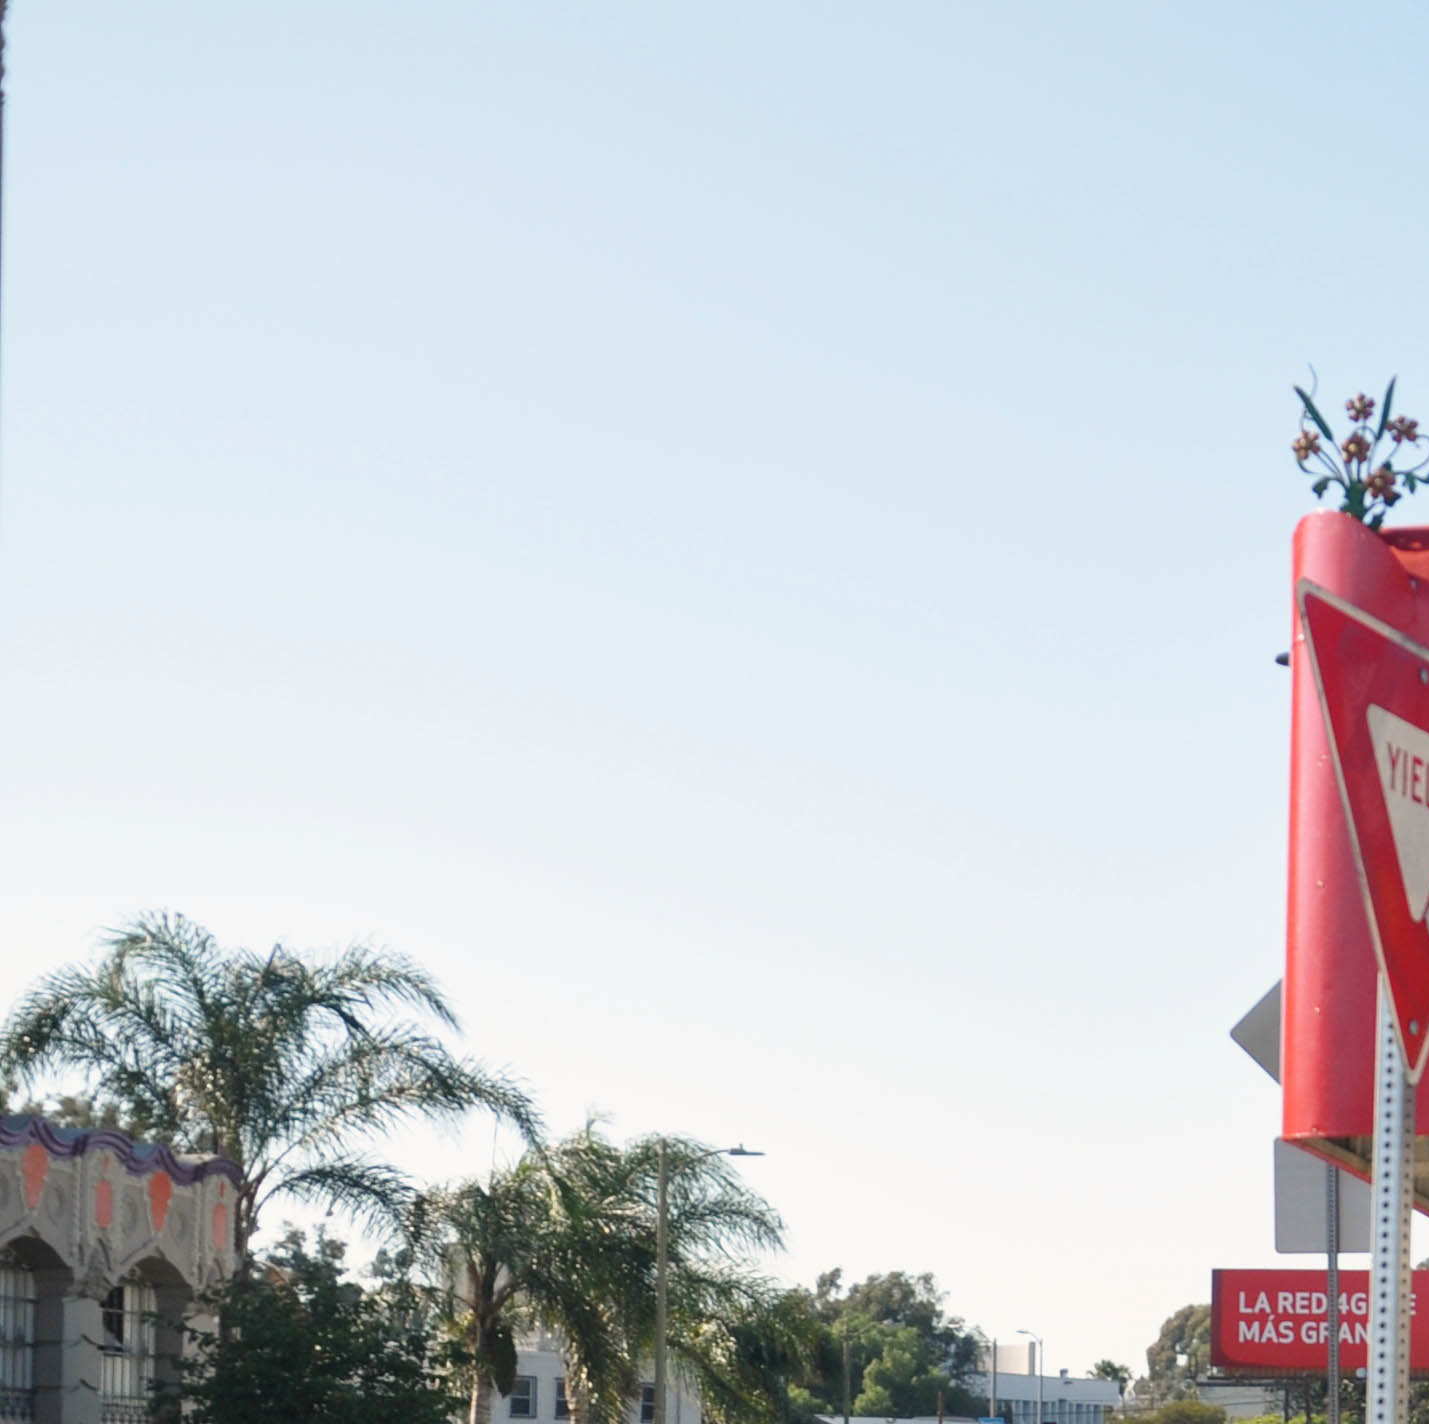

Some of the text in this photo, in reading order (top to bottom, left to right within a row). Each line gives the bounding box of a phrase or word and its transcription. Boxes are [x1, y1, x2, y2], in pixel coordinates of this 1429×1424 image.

[1238, 1291, 1272, 1314] LA
[1277, 1292, 1327, 1314] RED
[1238, 1314, 1294, 1344] MÁS
